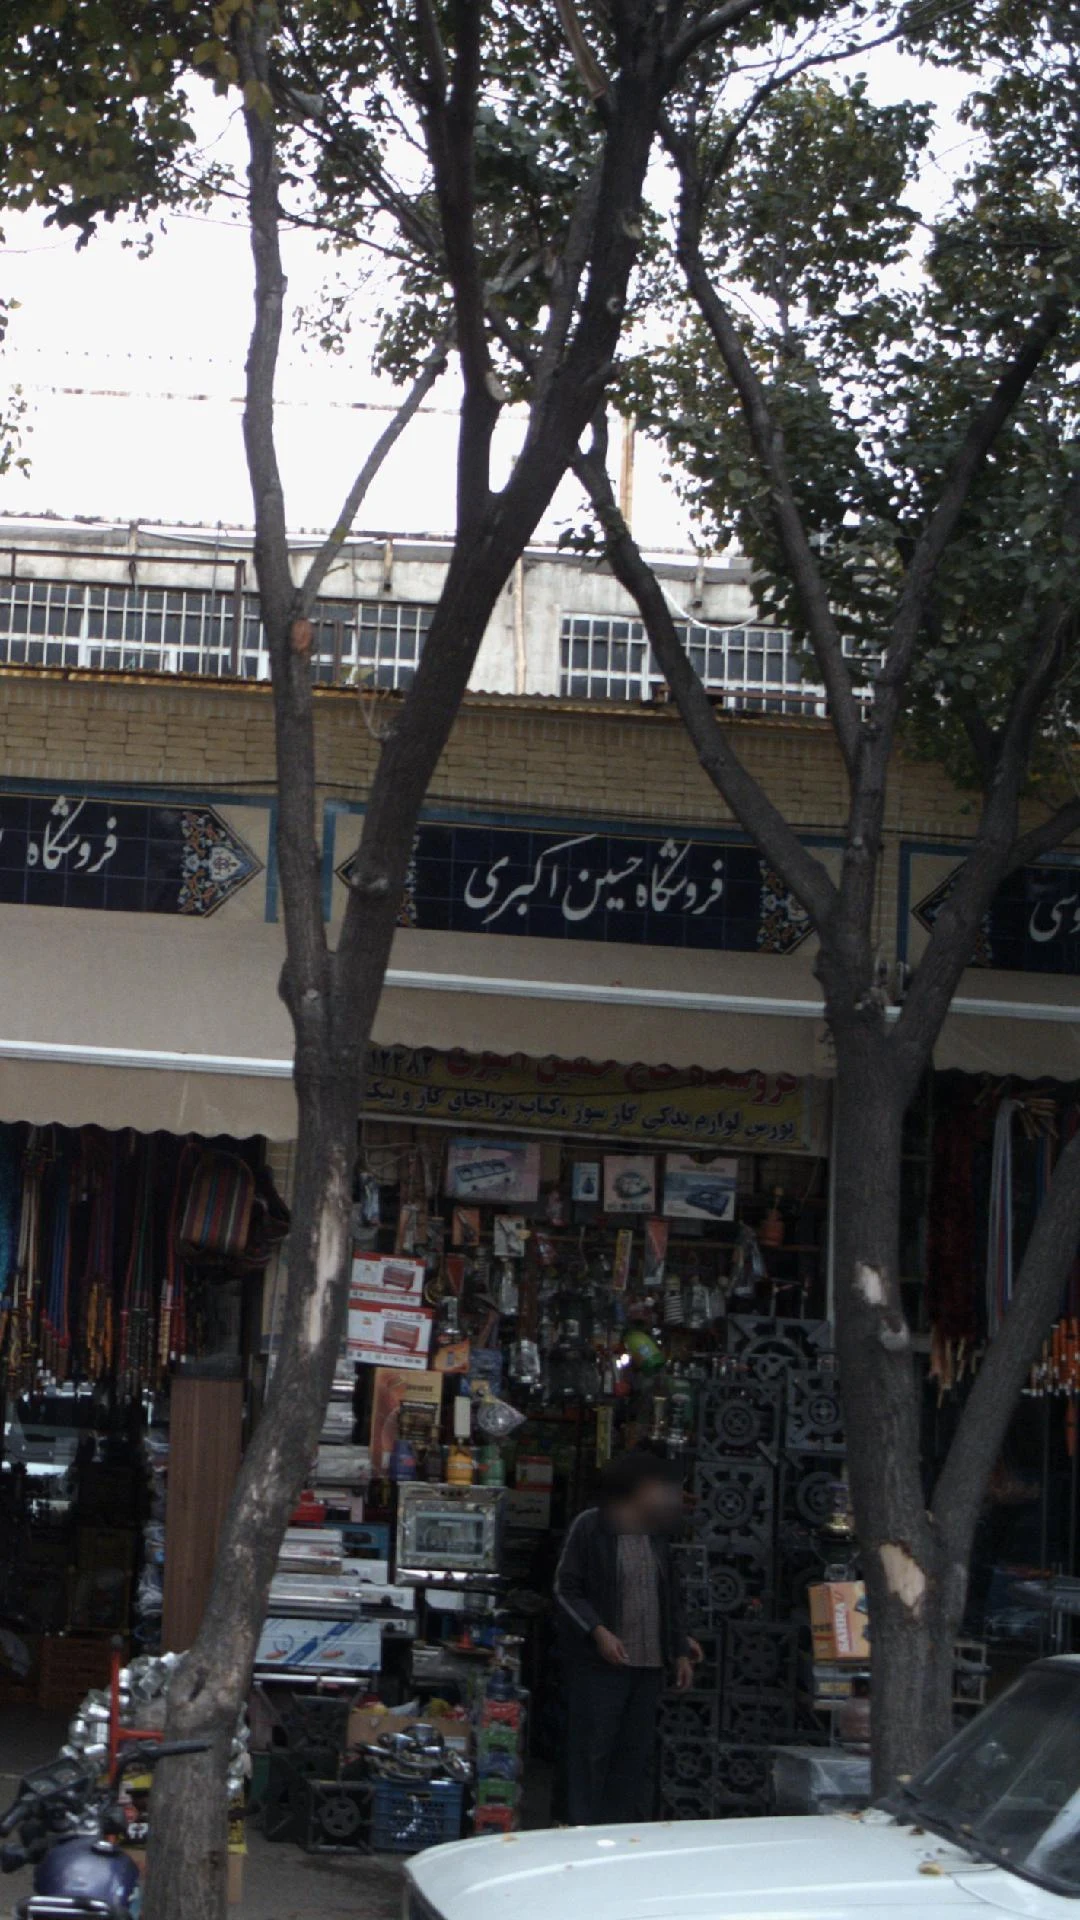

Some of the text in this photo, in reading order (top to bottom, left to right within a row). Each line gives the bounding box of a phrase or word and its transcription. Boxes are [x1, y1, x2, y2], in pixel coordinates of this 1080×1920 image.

[27, 795, 117, 873] فروشگاه
[464, 833, 724, 924] فروشگاه حسین اکبری
